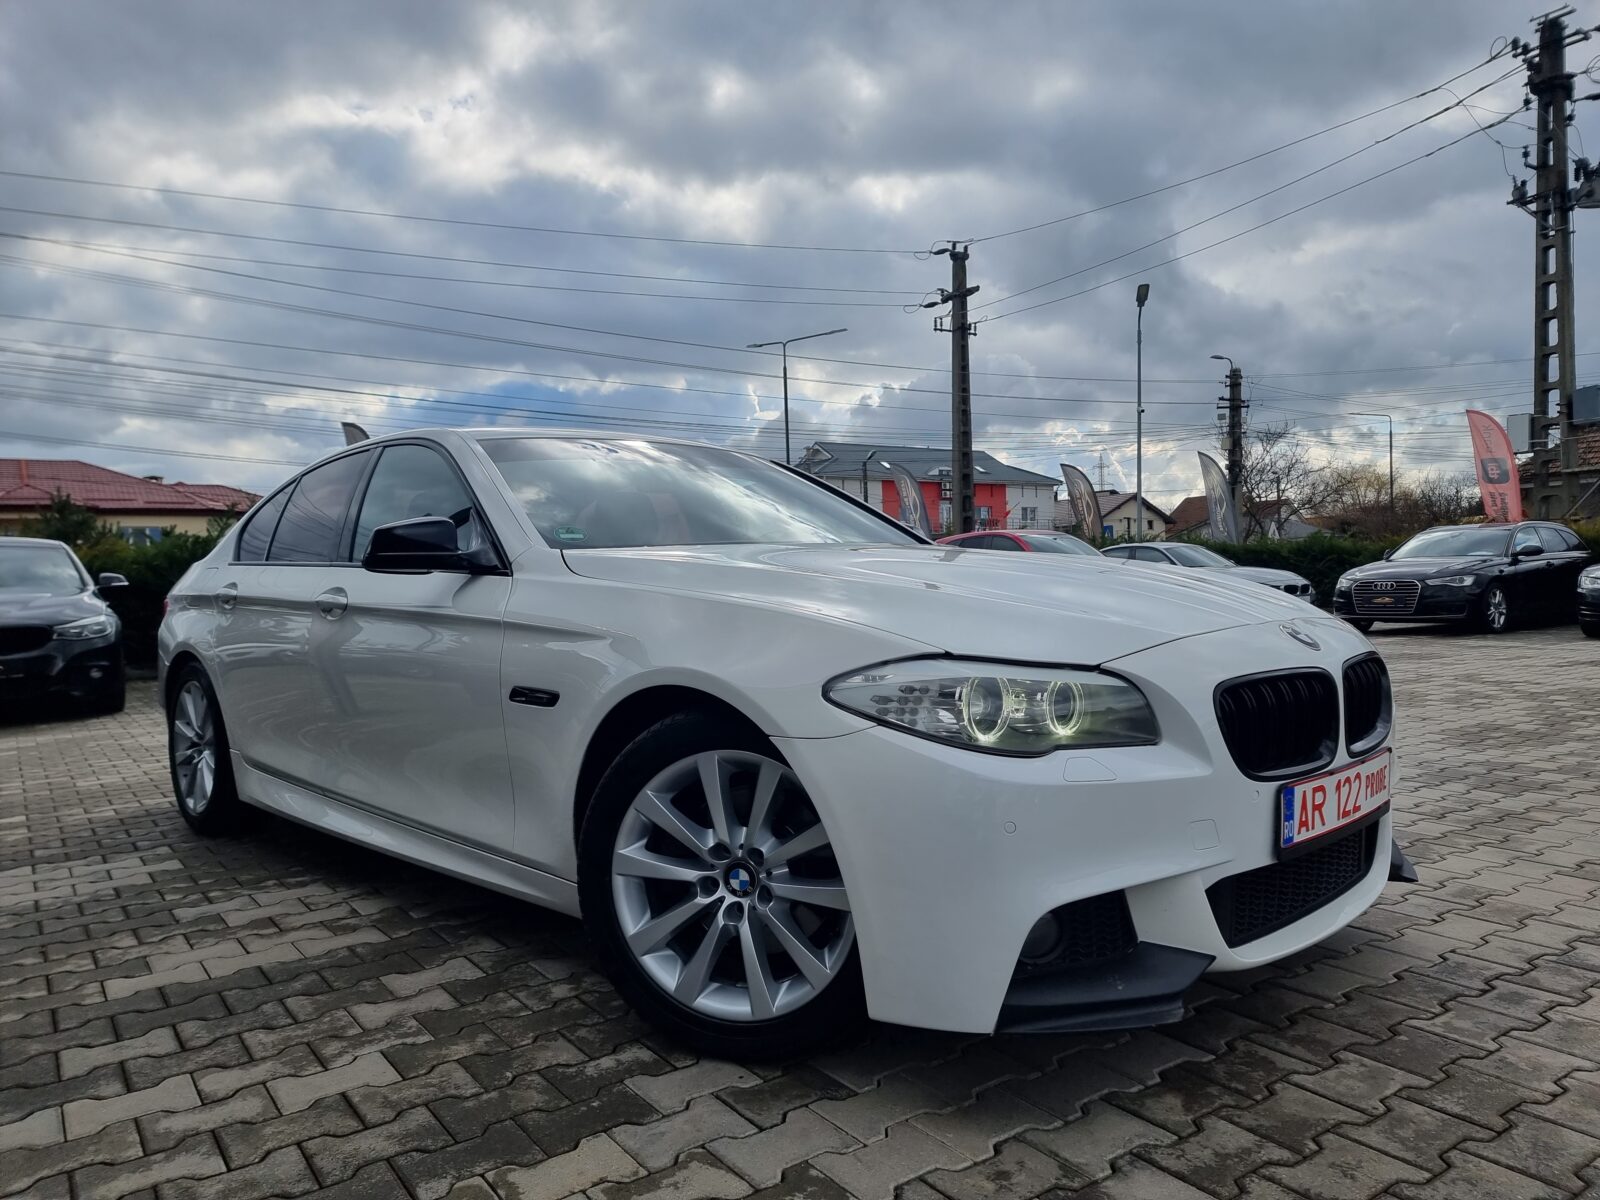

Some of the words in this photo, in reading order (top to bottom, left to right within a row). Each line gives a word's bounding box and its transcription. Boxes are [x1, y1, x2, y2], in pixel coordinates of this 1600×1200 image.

[1297, 784, 1327, 835] AR
[1335, 771, 1361, 821] 122
[1365, 764, 1388, 801] PROBE
[1283, 820, 1294, 840] RO
